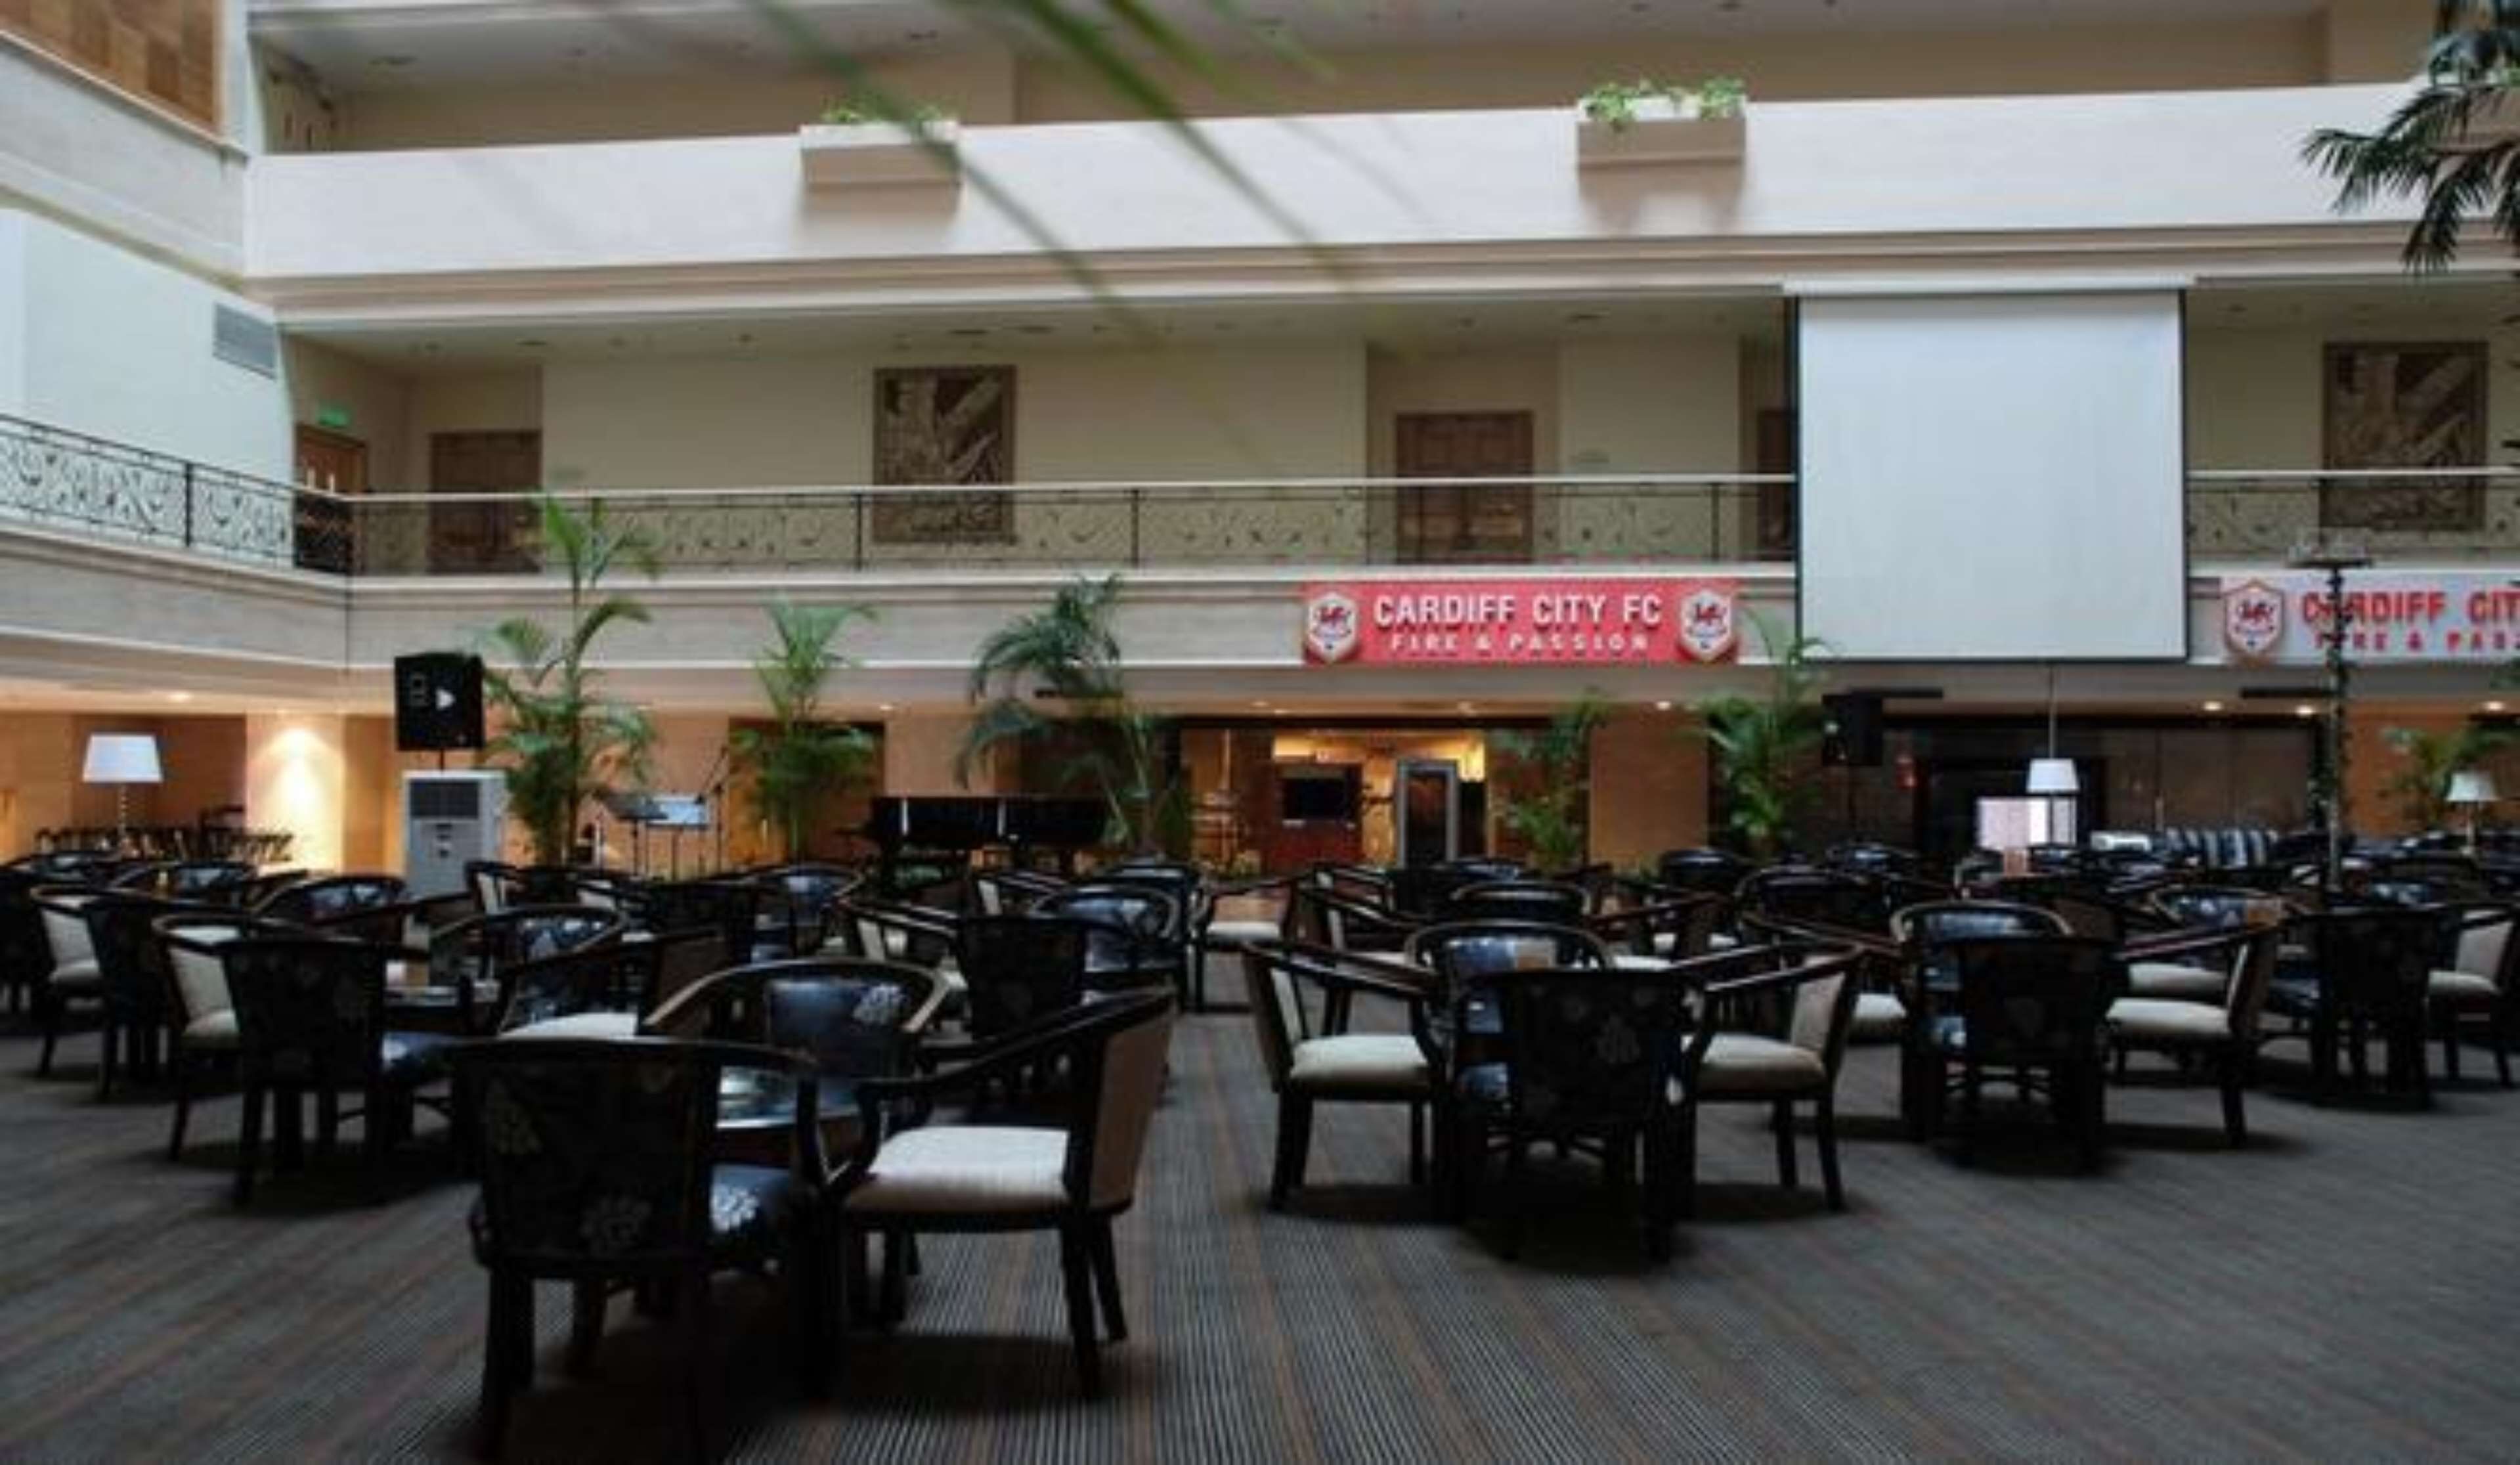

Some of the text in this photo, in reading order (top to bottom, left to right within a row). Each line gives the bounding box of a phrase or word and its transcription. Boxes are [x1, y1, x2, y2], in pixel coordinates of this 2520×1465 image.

[1374, 594, 1662, 626] CARDIFF CITY FC
[1391, 632, 1649, 651] FIRE & PASSION
[2314, 631, 2388, 650] FRE
